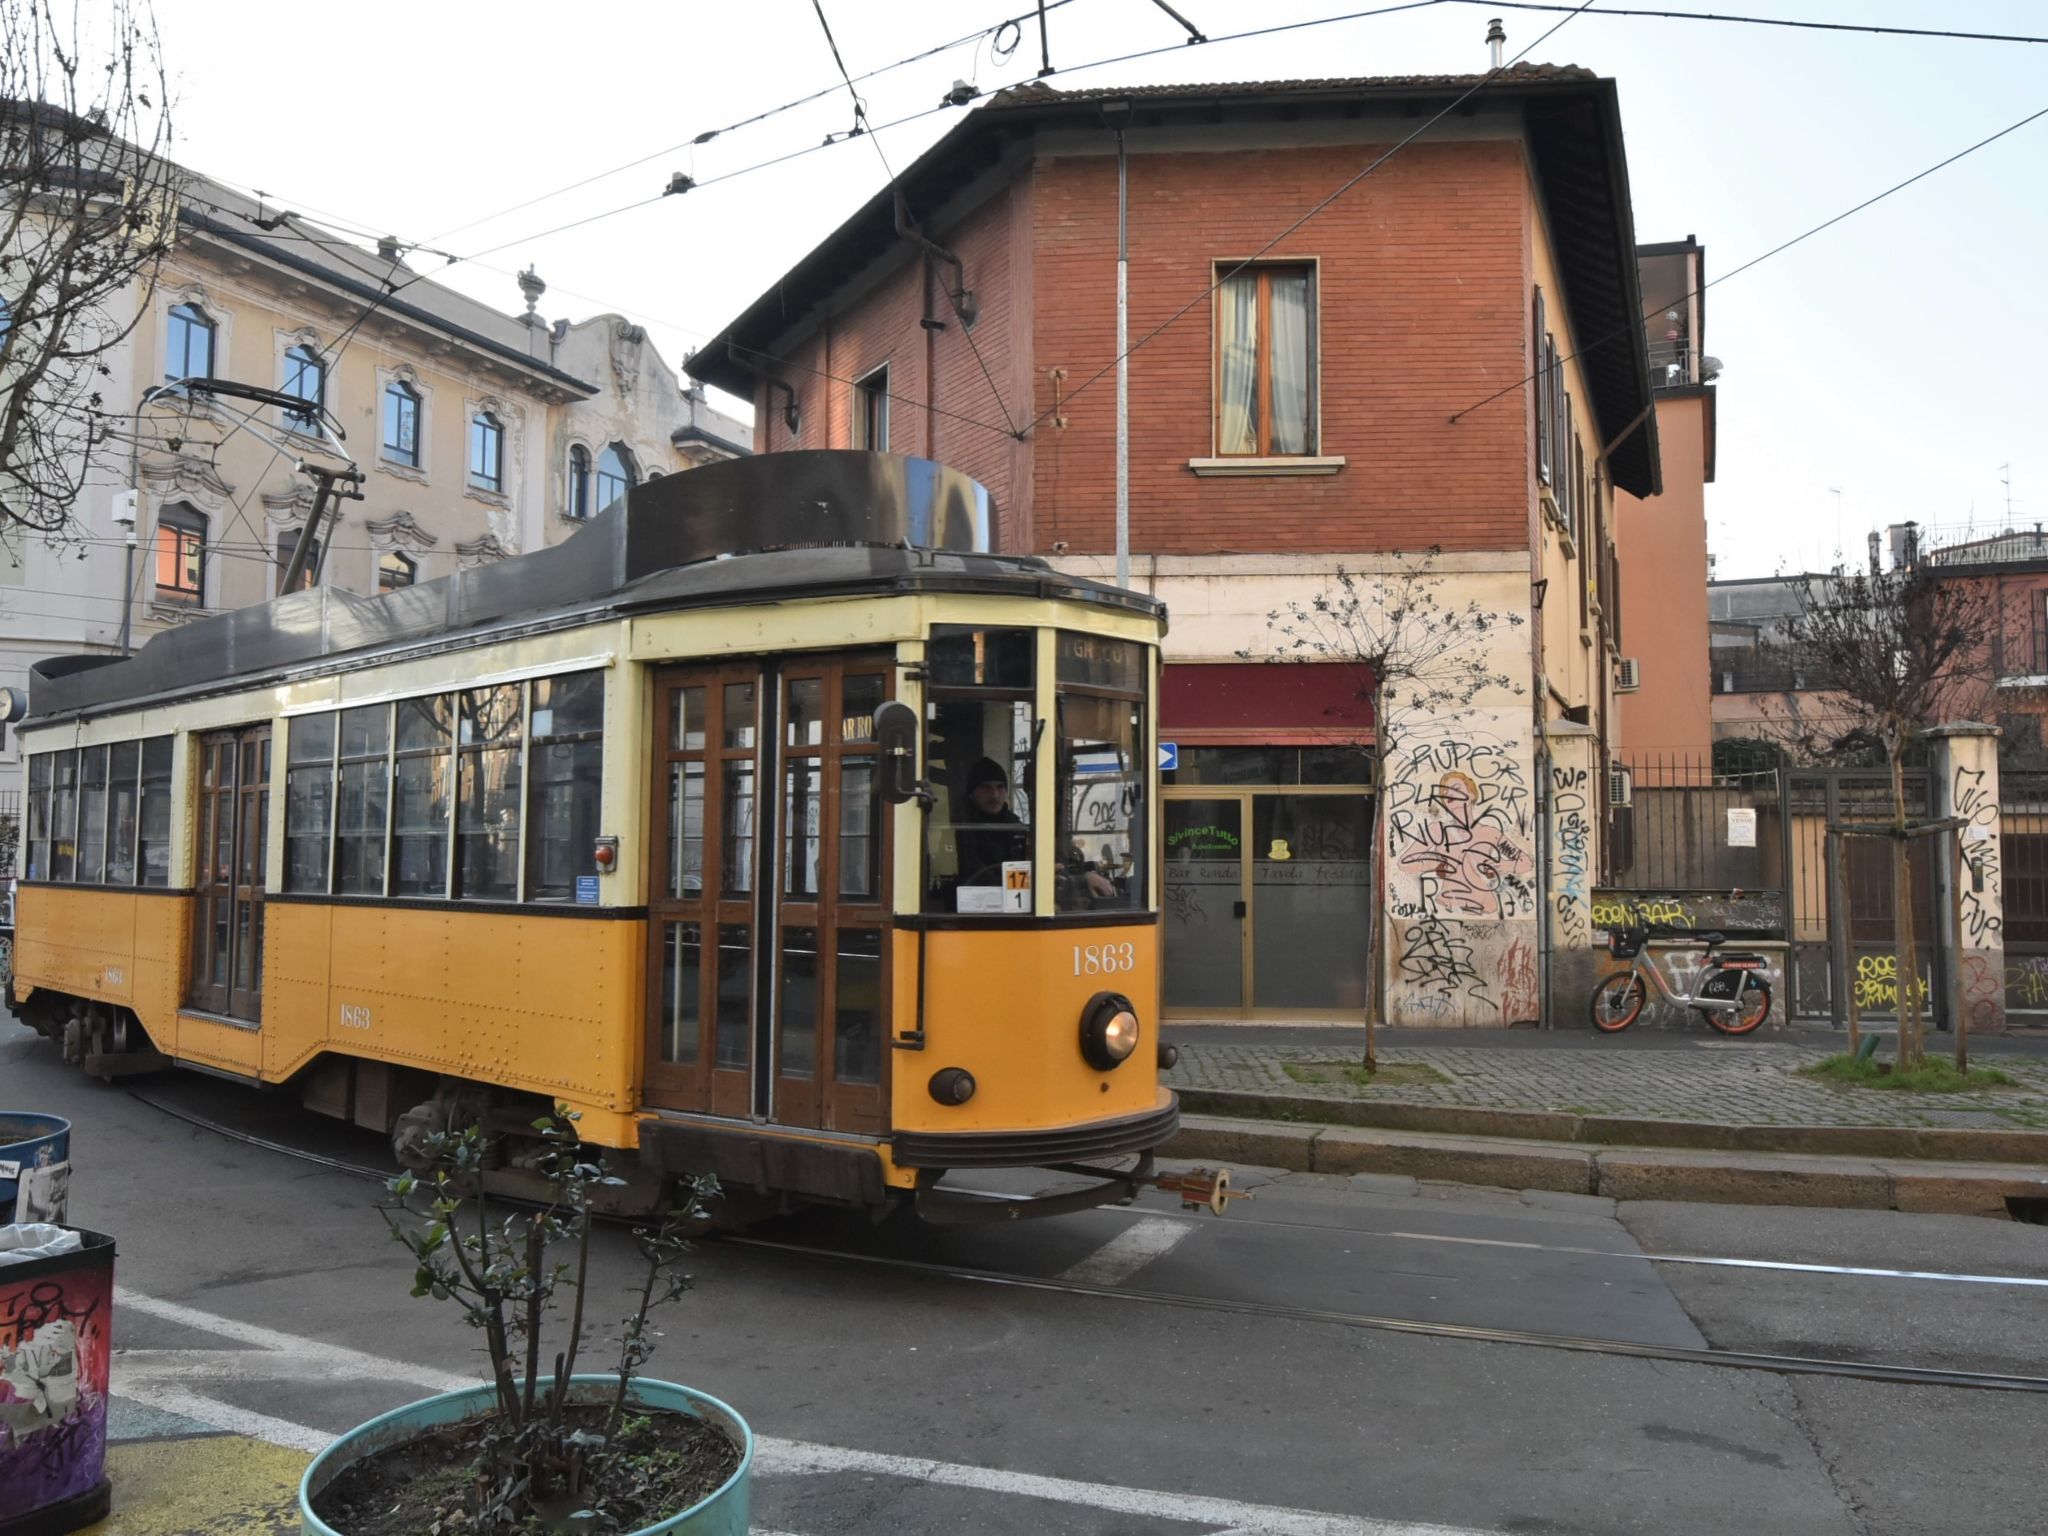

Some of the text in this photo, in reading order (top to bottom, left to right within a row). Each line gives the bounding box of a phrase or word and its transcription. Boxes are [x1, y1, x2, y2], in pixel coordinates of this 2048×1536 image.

[1009, 871, 1027, 889] 17
[1014, 892, 1023, 909] 1
[1073, 942, 1135, 976] 1863
[341, 1004, 371, 1031] 1863
